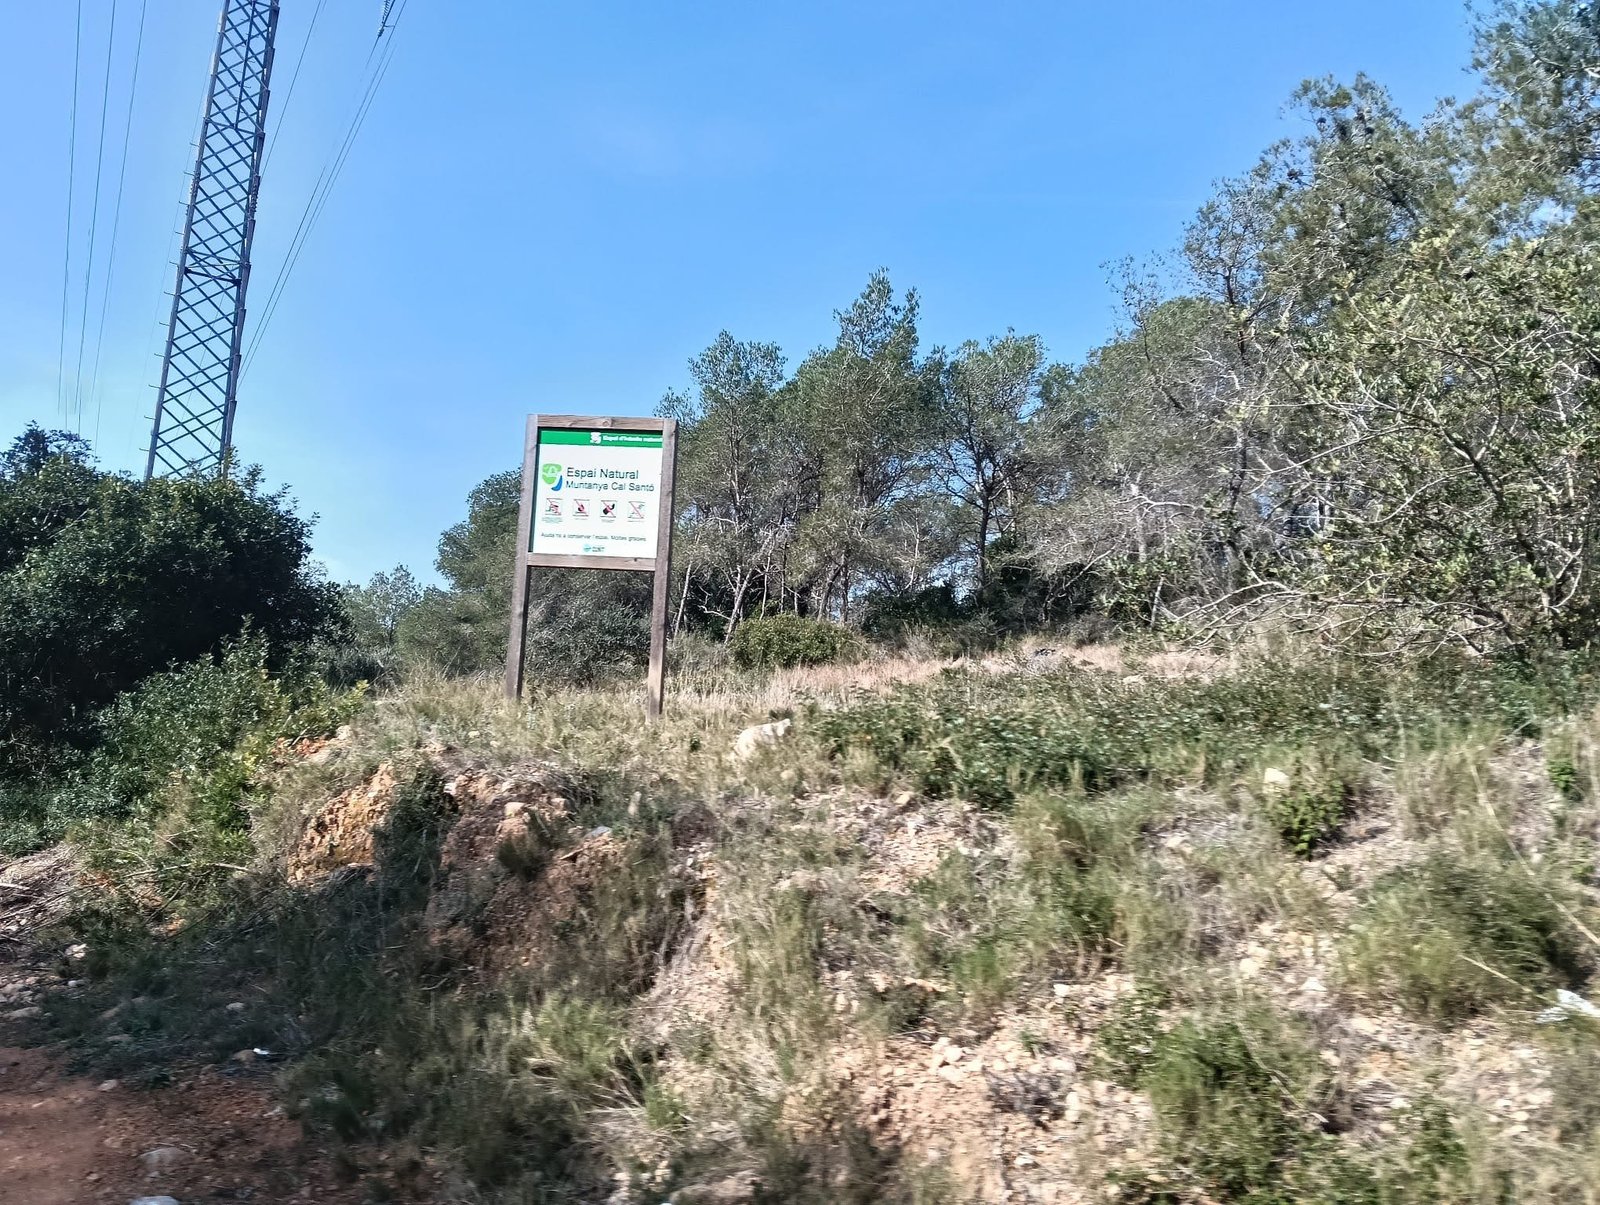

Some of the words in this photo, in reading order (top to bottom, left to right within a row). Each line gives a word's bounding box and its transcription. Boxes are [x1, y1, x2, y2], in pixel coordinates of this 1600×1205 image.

[566, 467, 597, 479] Espai
[600, 469, 639, 480] Natural
[566, 480, 608, 492] Muntanya
[611, 482, 626, 490] Cal
[628, 482, 654, 492] Santó
